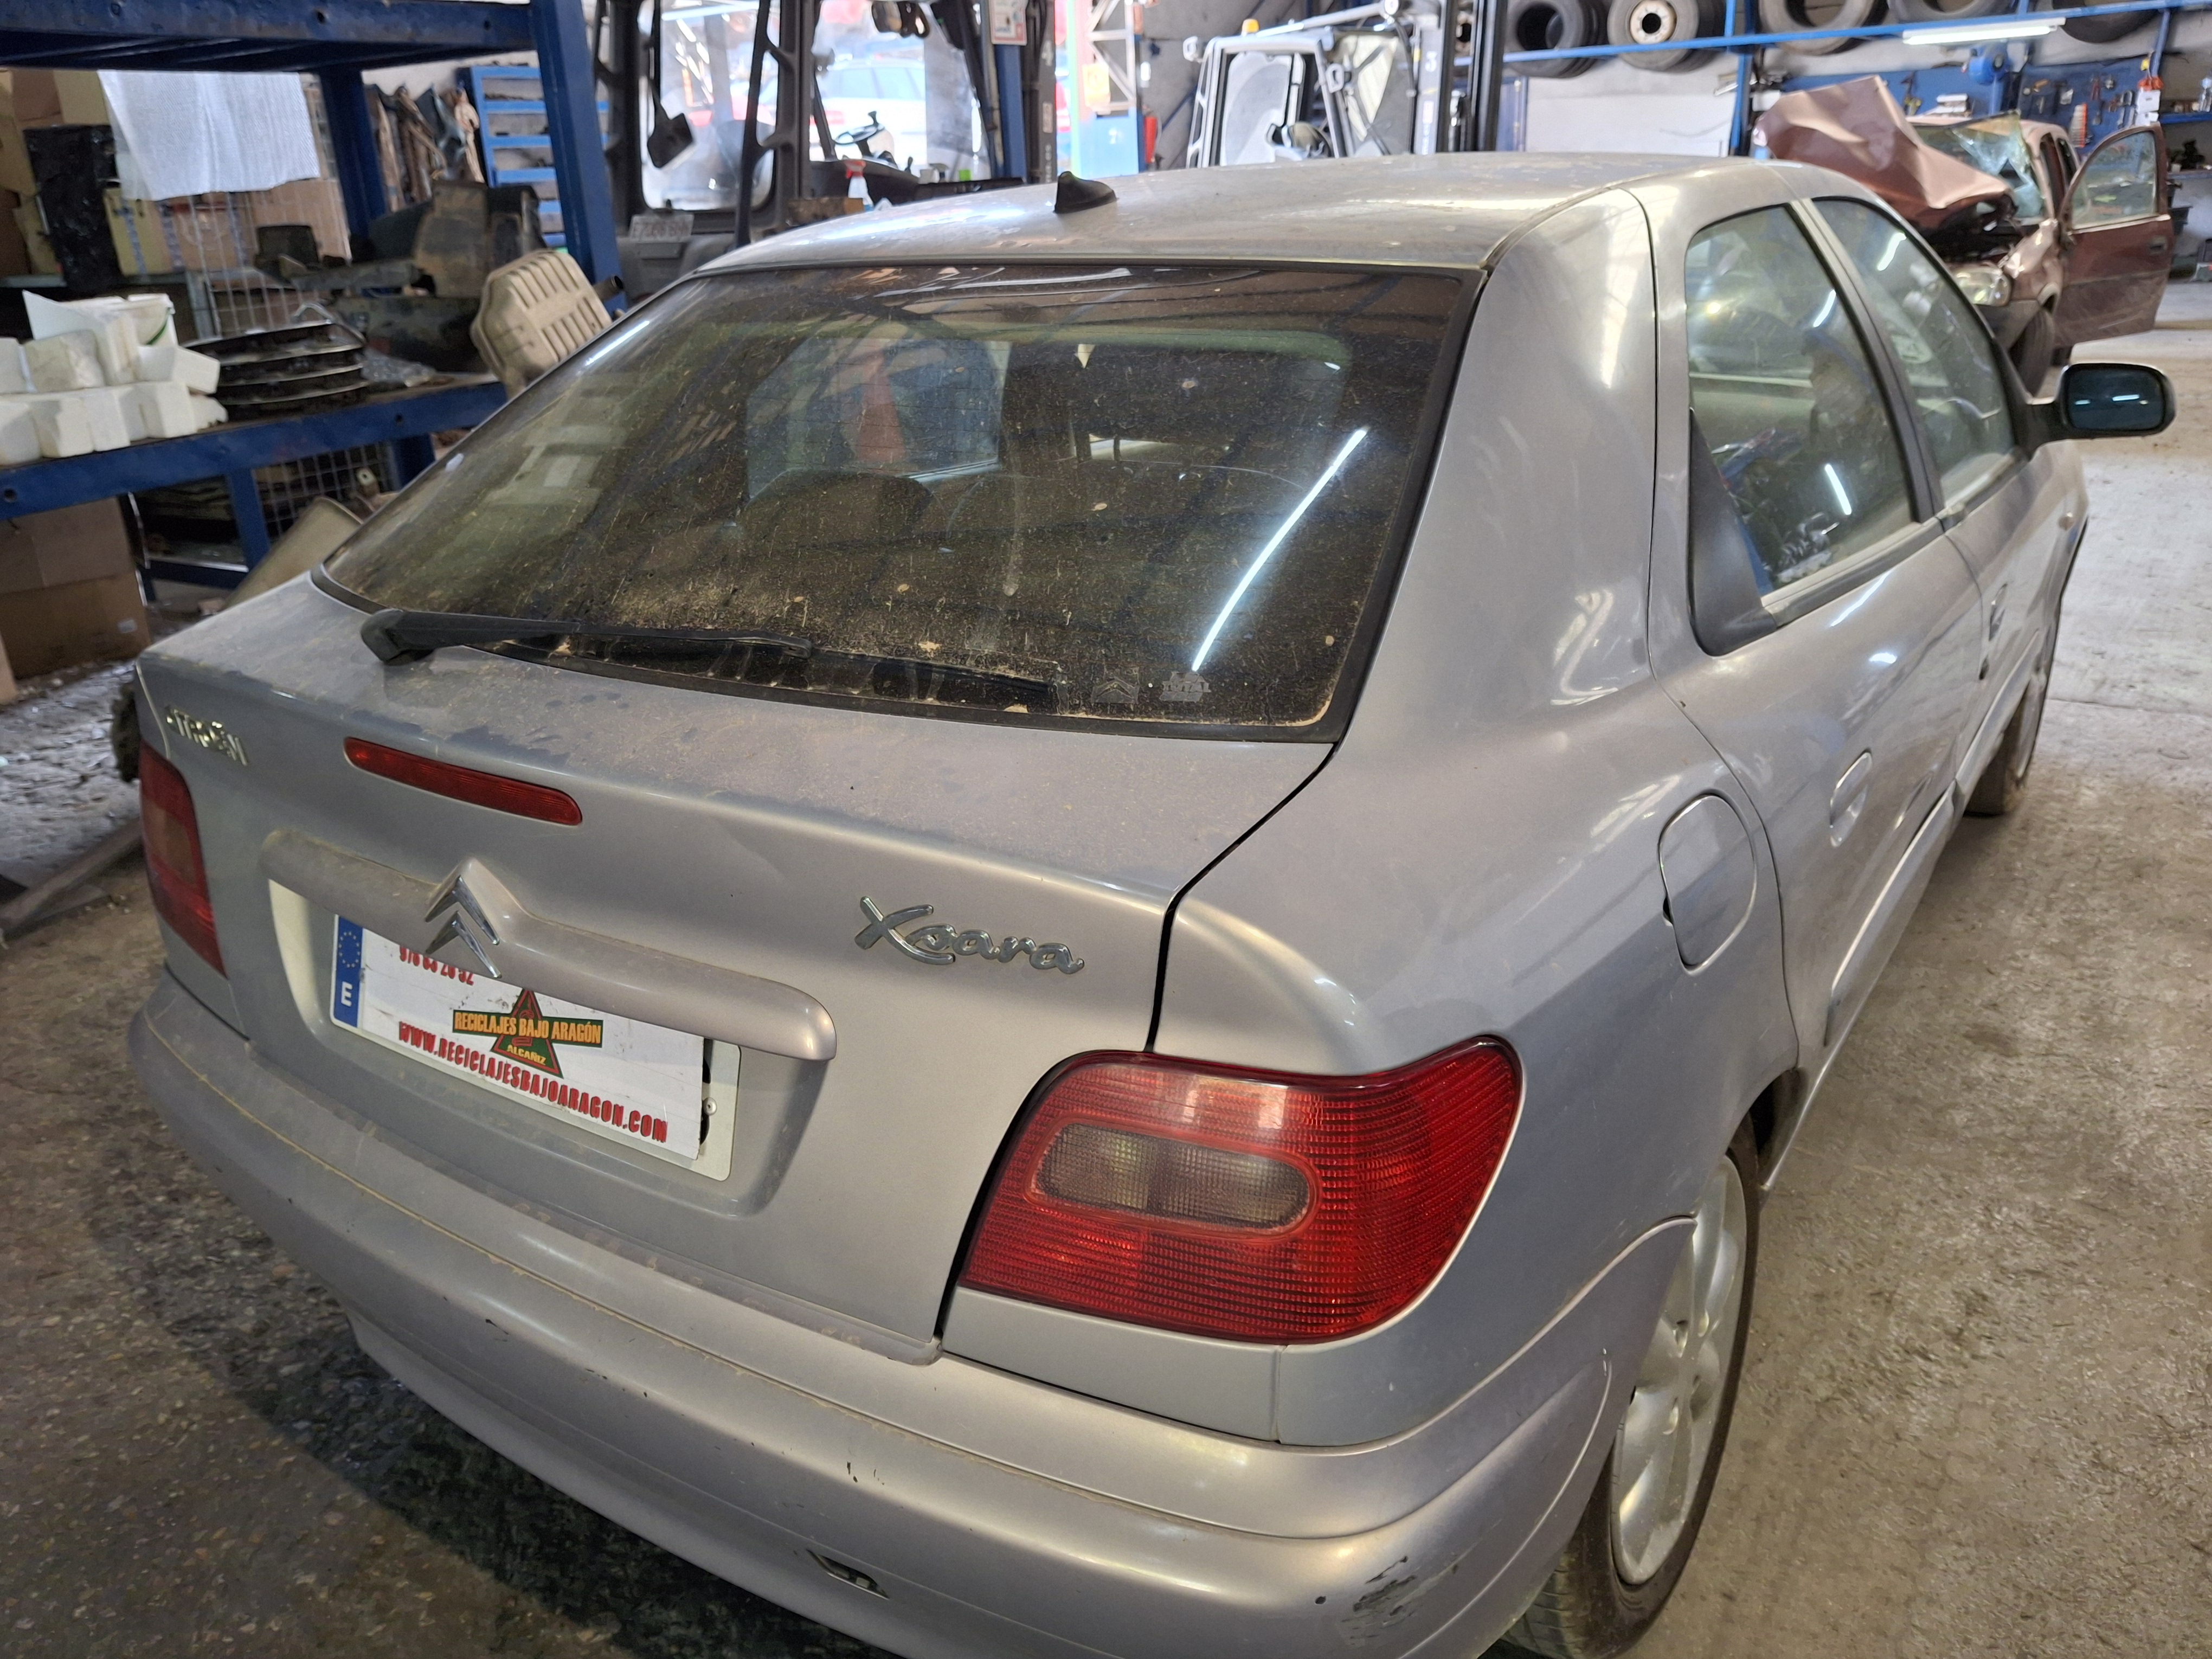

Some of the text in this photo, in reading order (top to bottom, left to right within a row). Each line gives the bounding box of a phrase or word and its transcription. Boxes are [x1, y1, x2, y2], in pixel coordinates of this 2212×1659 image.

[854, 896, 1084, 974] Xsara
[341, 981, 353, 1007] E
[454, 1012, 601, 1044] RECICLAJES BAJO ARAGÓN
[506, 1044, 546, 1066] ALCAÑIZ
[399, 1021, 668, 1143] WWW.RECICLAJESBAJOARAGON.COM
